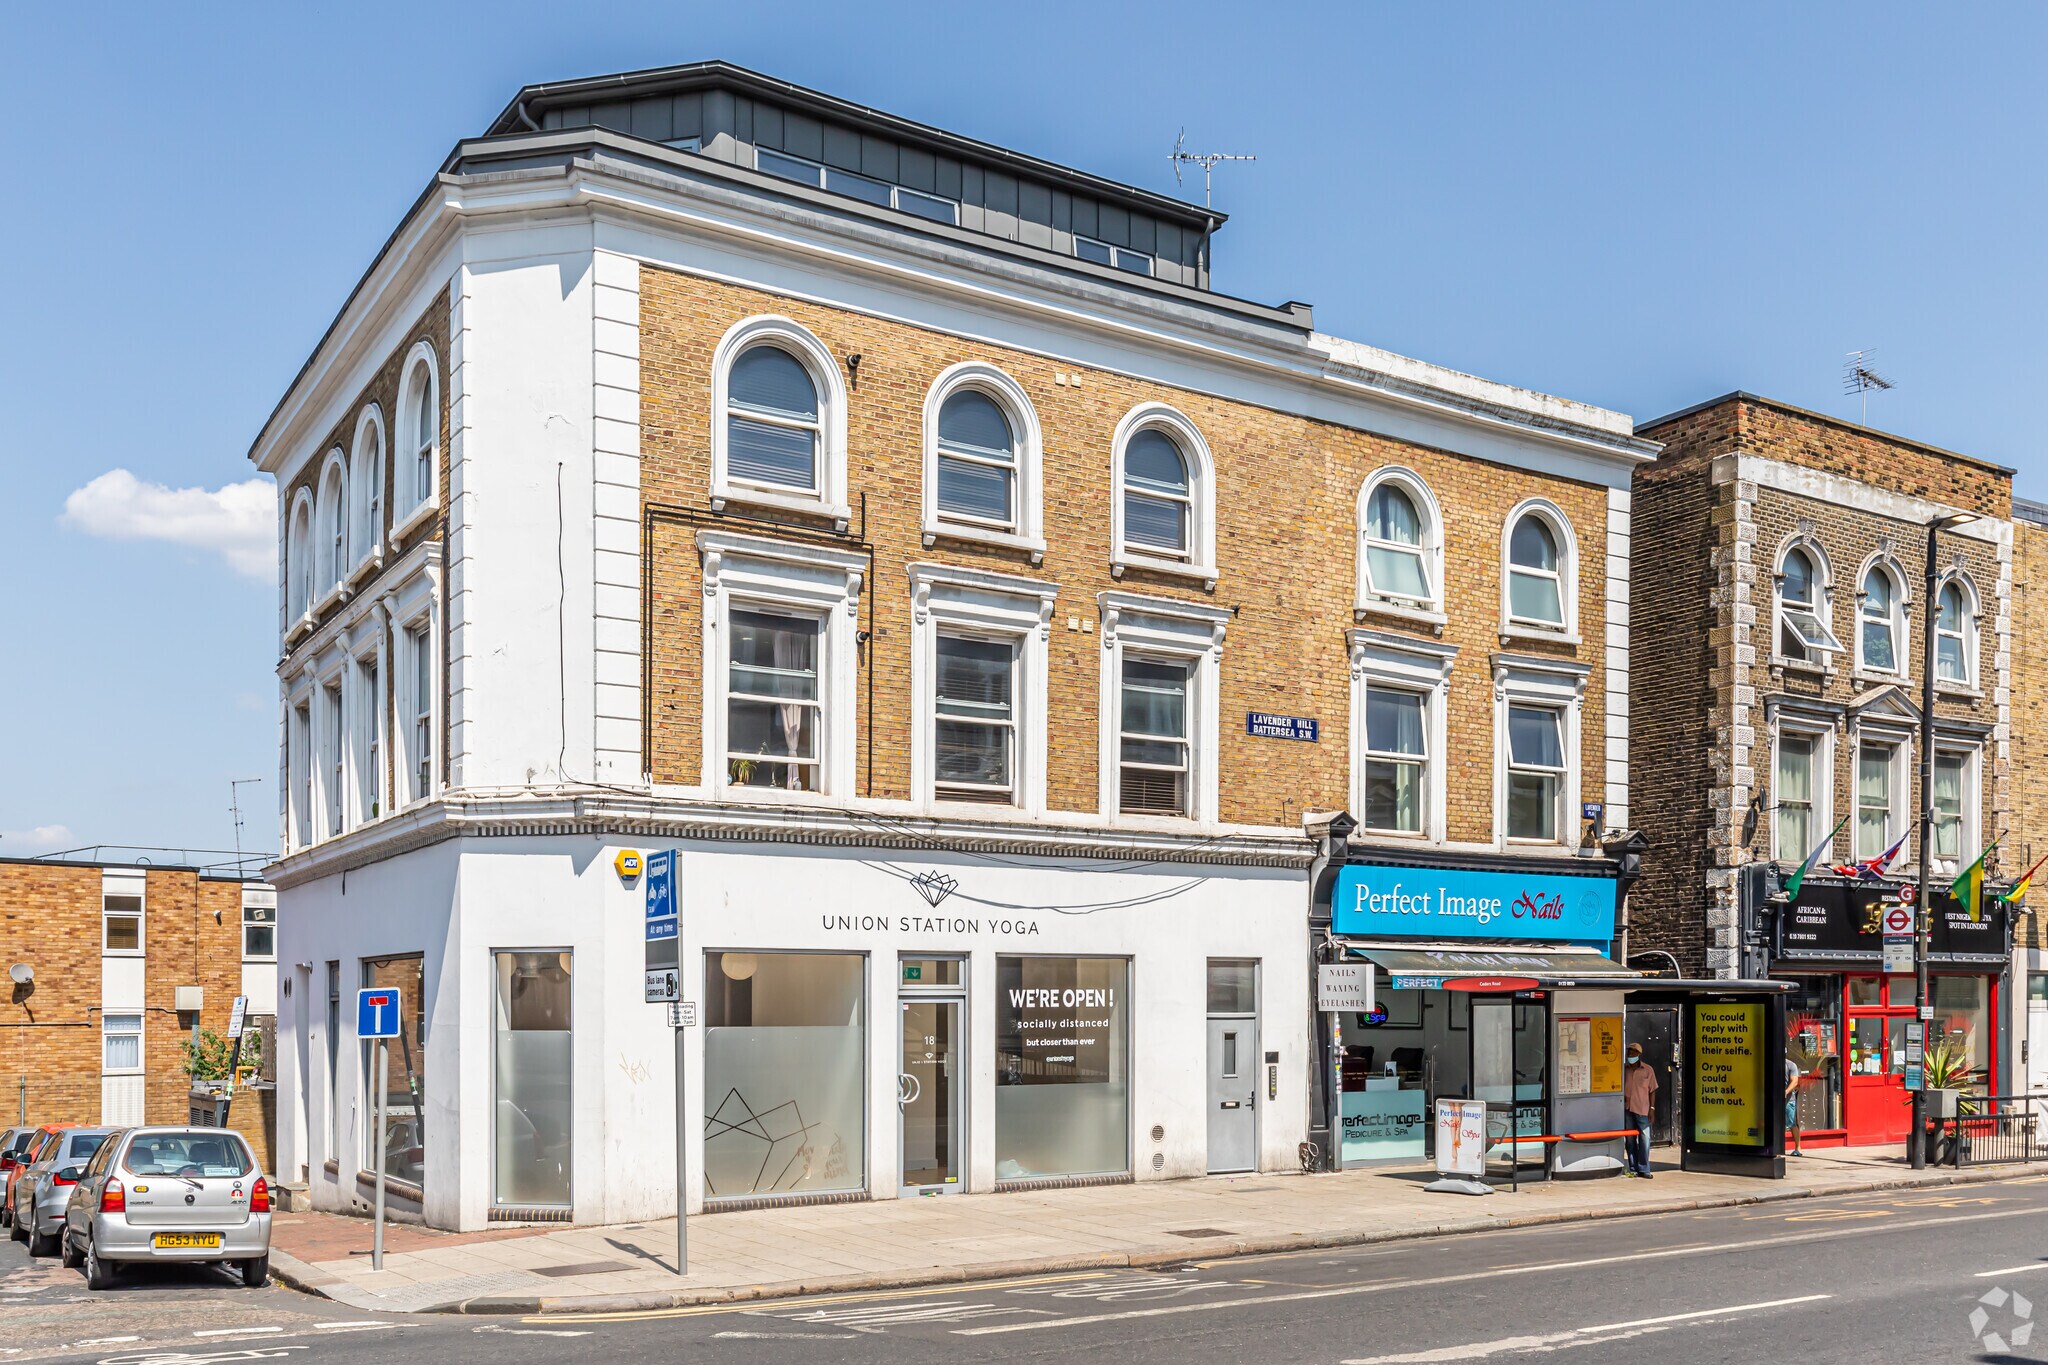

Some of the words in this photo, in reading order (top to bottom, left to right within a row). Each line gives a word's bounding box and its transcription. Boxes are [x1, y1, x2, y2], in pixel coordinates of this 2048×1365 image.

[1253, 714, 1291, 727] LAVENDER
[1297, 720, 1313, 729] HILL
[1253, 725, 1295, 737] BATTERSEA
[1299, 730, 1313, 739] S.W.
[624, 859, 637, 867] ADT
[1900, 887, 1912, 900] G
[1354, 883, 1432, 914] Perfect
[1438, 888, 1502, 924] Image
[1511, 889, 1565, 920] Nails
[1797, 906, 1821, 914] AFRICAN
[1796, 915, 1827, 924] CARIBBEAN
[650, 925, 655, 934] At
[664, 923, 673, 932] time
[822, 915, 889, 931] UNION
[900, 917, 979, 933] STATION
[988, 920, 1039, 935] YOGA
[1330, 969, 1356, 977] NAILS
[647, 976, 655, 984] Bus
[656, 975, 665, 984] lane
[1397, 977, 1438, 987] PERFECT
[1370, 1013, 1386, 1022] Spa
[1701, 1013, 1717, 1021] You
[1719, 1013, 1745, 1021] could
[1017, 1019, 1057, 1029] socially
[1060, 1019, 1109, 1027] distanced
[1702, 1024, 1725, 1034] reply
[1728, 1024, 1748, 1032] with
[924, 1035, 935, 1045] 18
[1040, 1038, 1061, 1046] closer
[1701, 1035, 1731, 1044] flames
[1734, 1035, 1744, 1044] to
[1701, 1046, 1722, 1055] their
[1725, 1046, 1752, 1055] selfie.
[1702, 1062, 1713, 1071] Or
[1715, 1064, 1732, 1073] you
[1702, 1074, 1727, 1082] could
[1701, 1084, 1718, 1095] just
[1720, 1085, 1736, 1094] ask
[1701, 1096, 1724, 1105] them
[1727, 1097, 1745, 1106] out.
[1463, 1111, 1482, 1119] Image
[1345, 1129, 1382, 1139] PEDICURE
[1385, 1128, 1391, 1136] &
[160, 1235, 189, 1245] HG53
[193, 1235, 215, 1245] NYU
